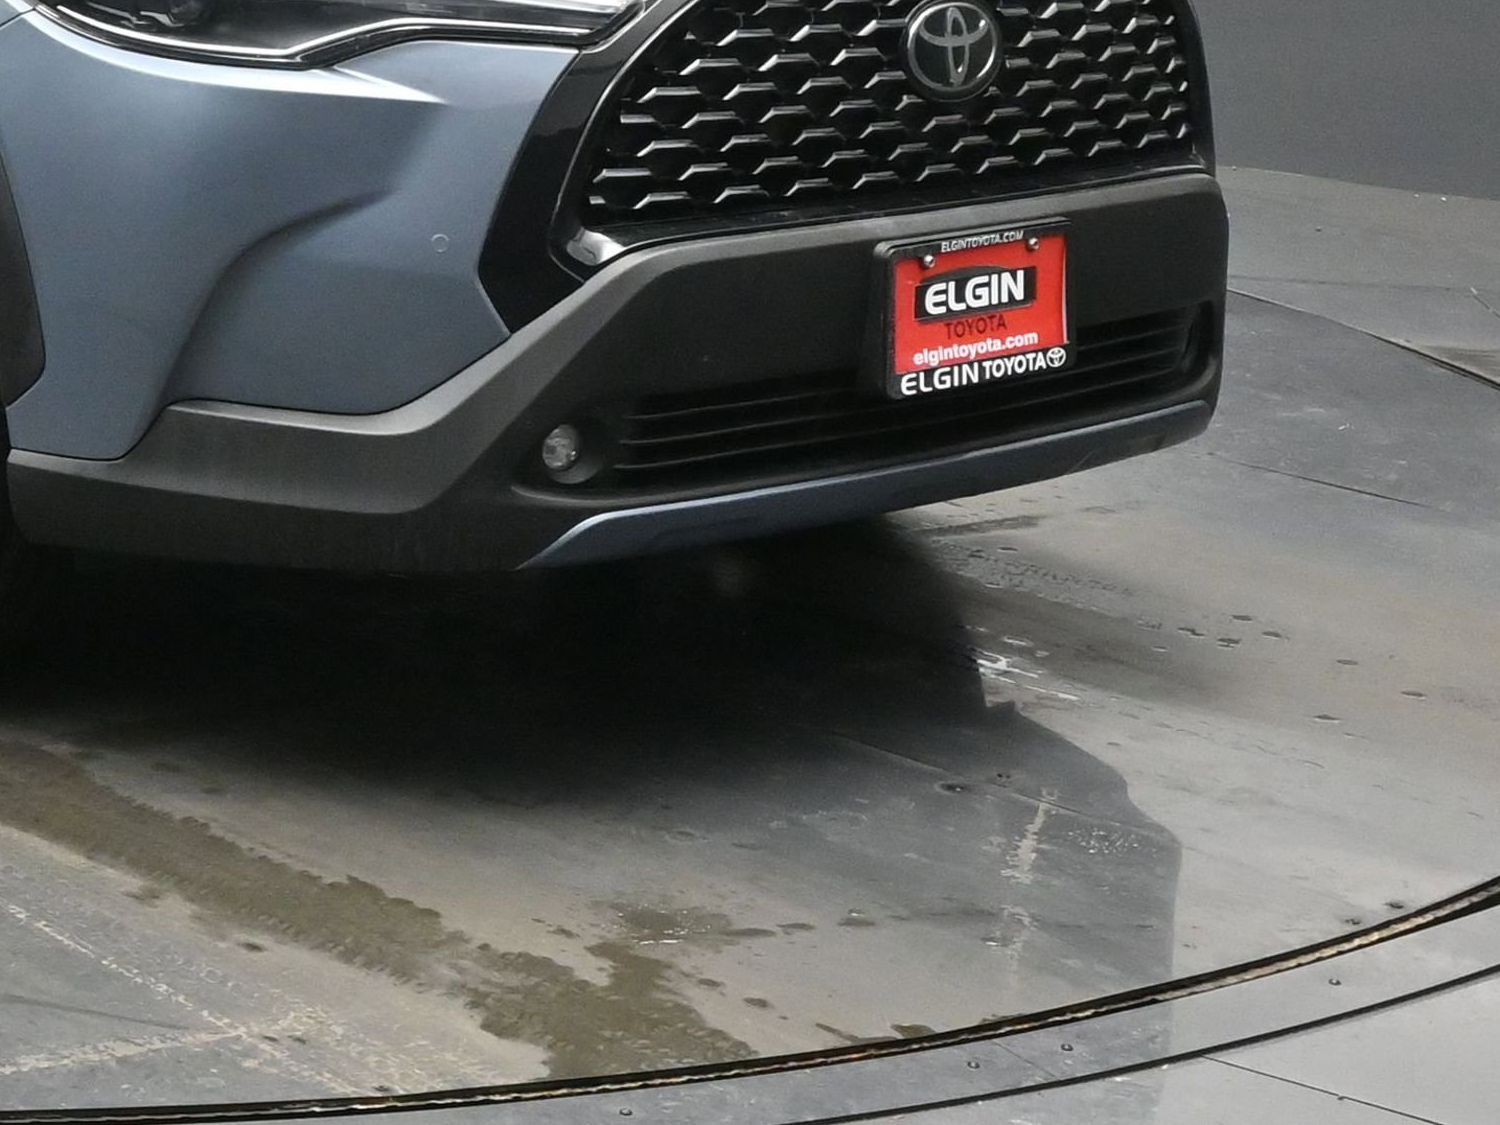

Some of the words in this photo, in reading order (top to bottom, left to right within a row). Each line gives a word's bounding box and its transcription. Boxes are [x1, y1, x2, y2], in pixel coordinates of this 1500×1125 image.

[941, 230, 1024, 253] ELGINTOYOTA.COM
[924, 269, 1025, 315] ELGIN
[944, 314, 1008, 340] TOYOTA
[912, 332, 1039, 366] elgintoyota.com
[900, 362, 980, 396] ELGIN
[982, 351, 1047, 380] TOYOTA
